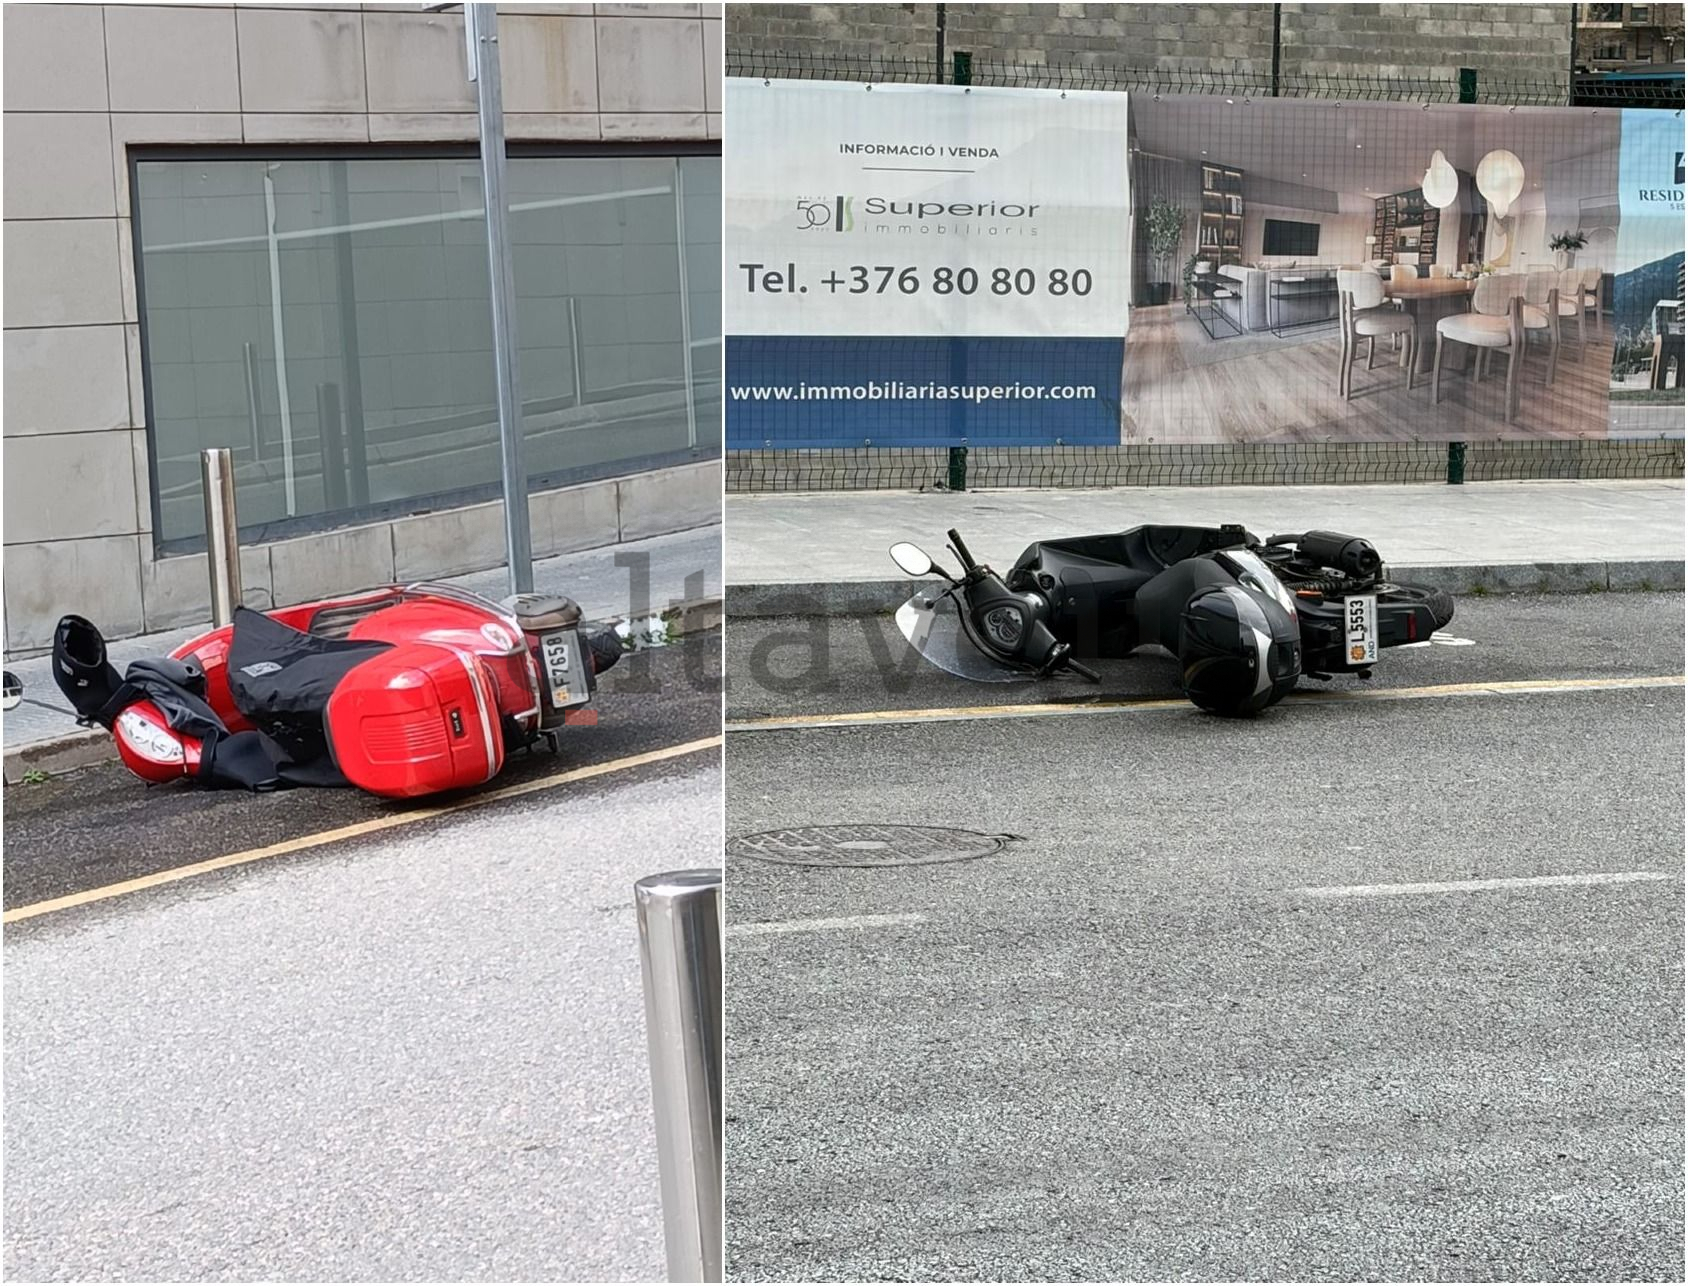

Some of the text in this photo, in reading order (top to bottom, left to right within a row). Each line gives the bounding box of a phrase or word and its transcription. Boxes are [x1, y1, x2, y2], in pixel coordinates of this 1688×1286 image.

[839, 143, 999, 158] INFORMACIÓ I VENDA
[1639, 189, 1685, 201] RESID
[865, 197, 1040, 219] Superior
[864, 223, 1038, 237] immobiliaris
[739, 263, 1093, 296] Tel. +376 80 80 80
[730, 382, 1096, 403] www.immobiliariasuperior.com
[1350, 600, 1365, 642] L5553
[546, 637, 571, 688] F7658
